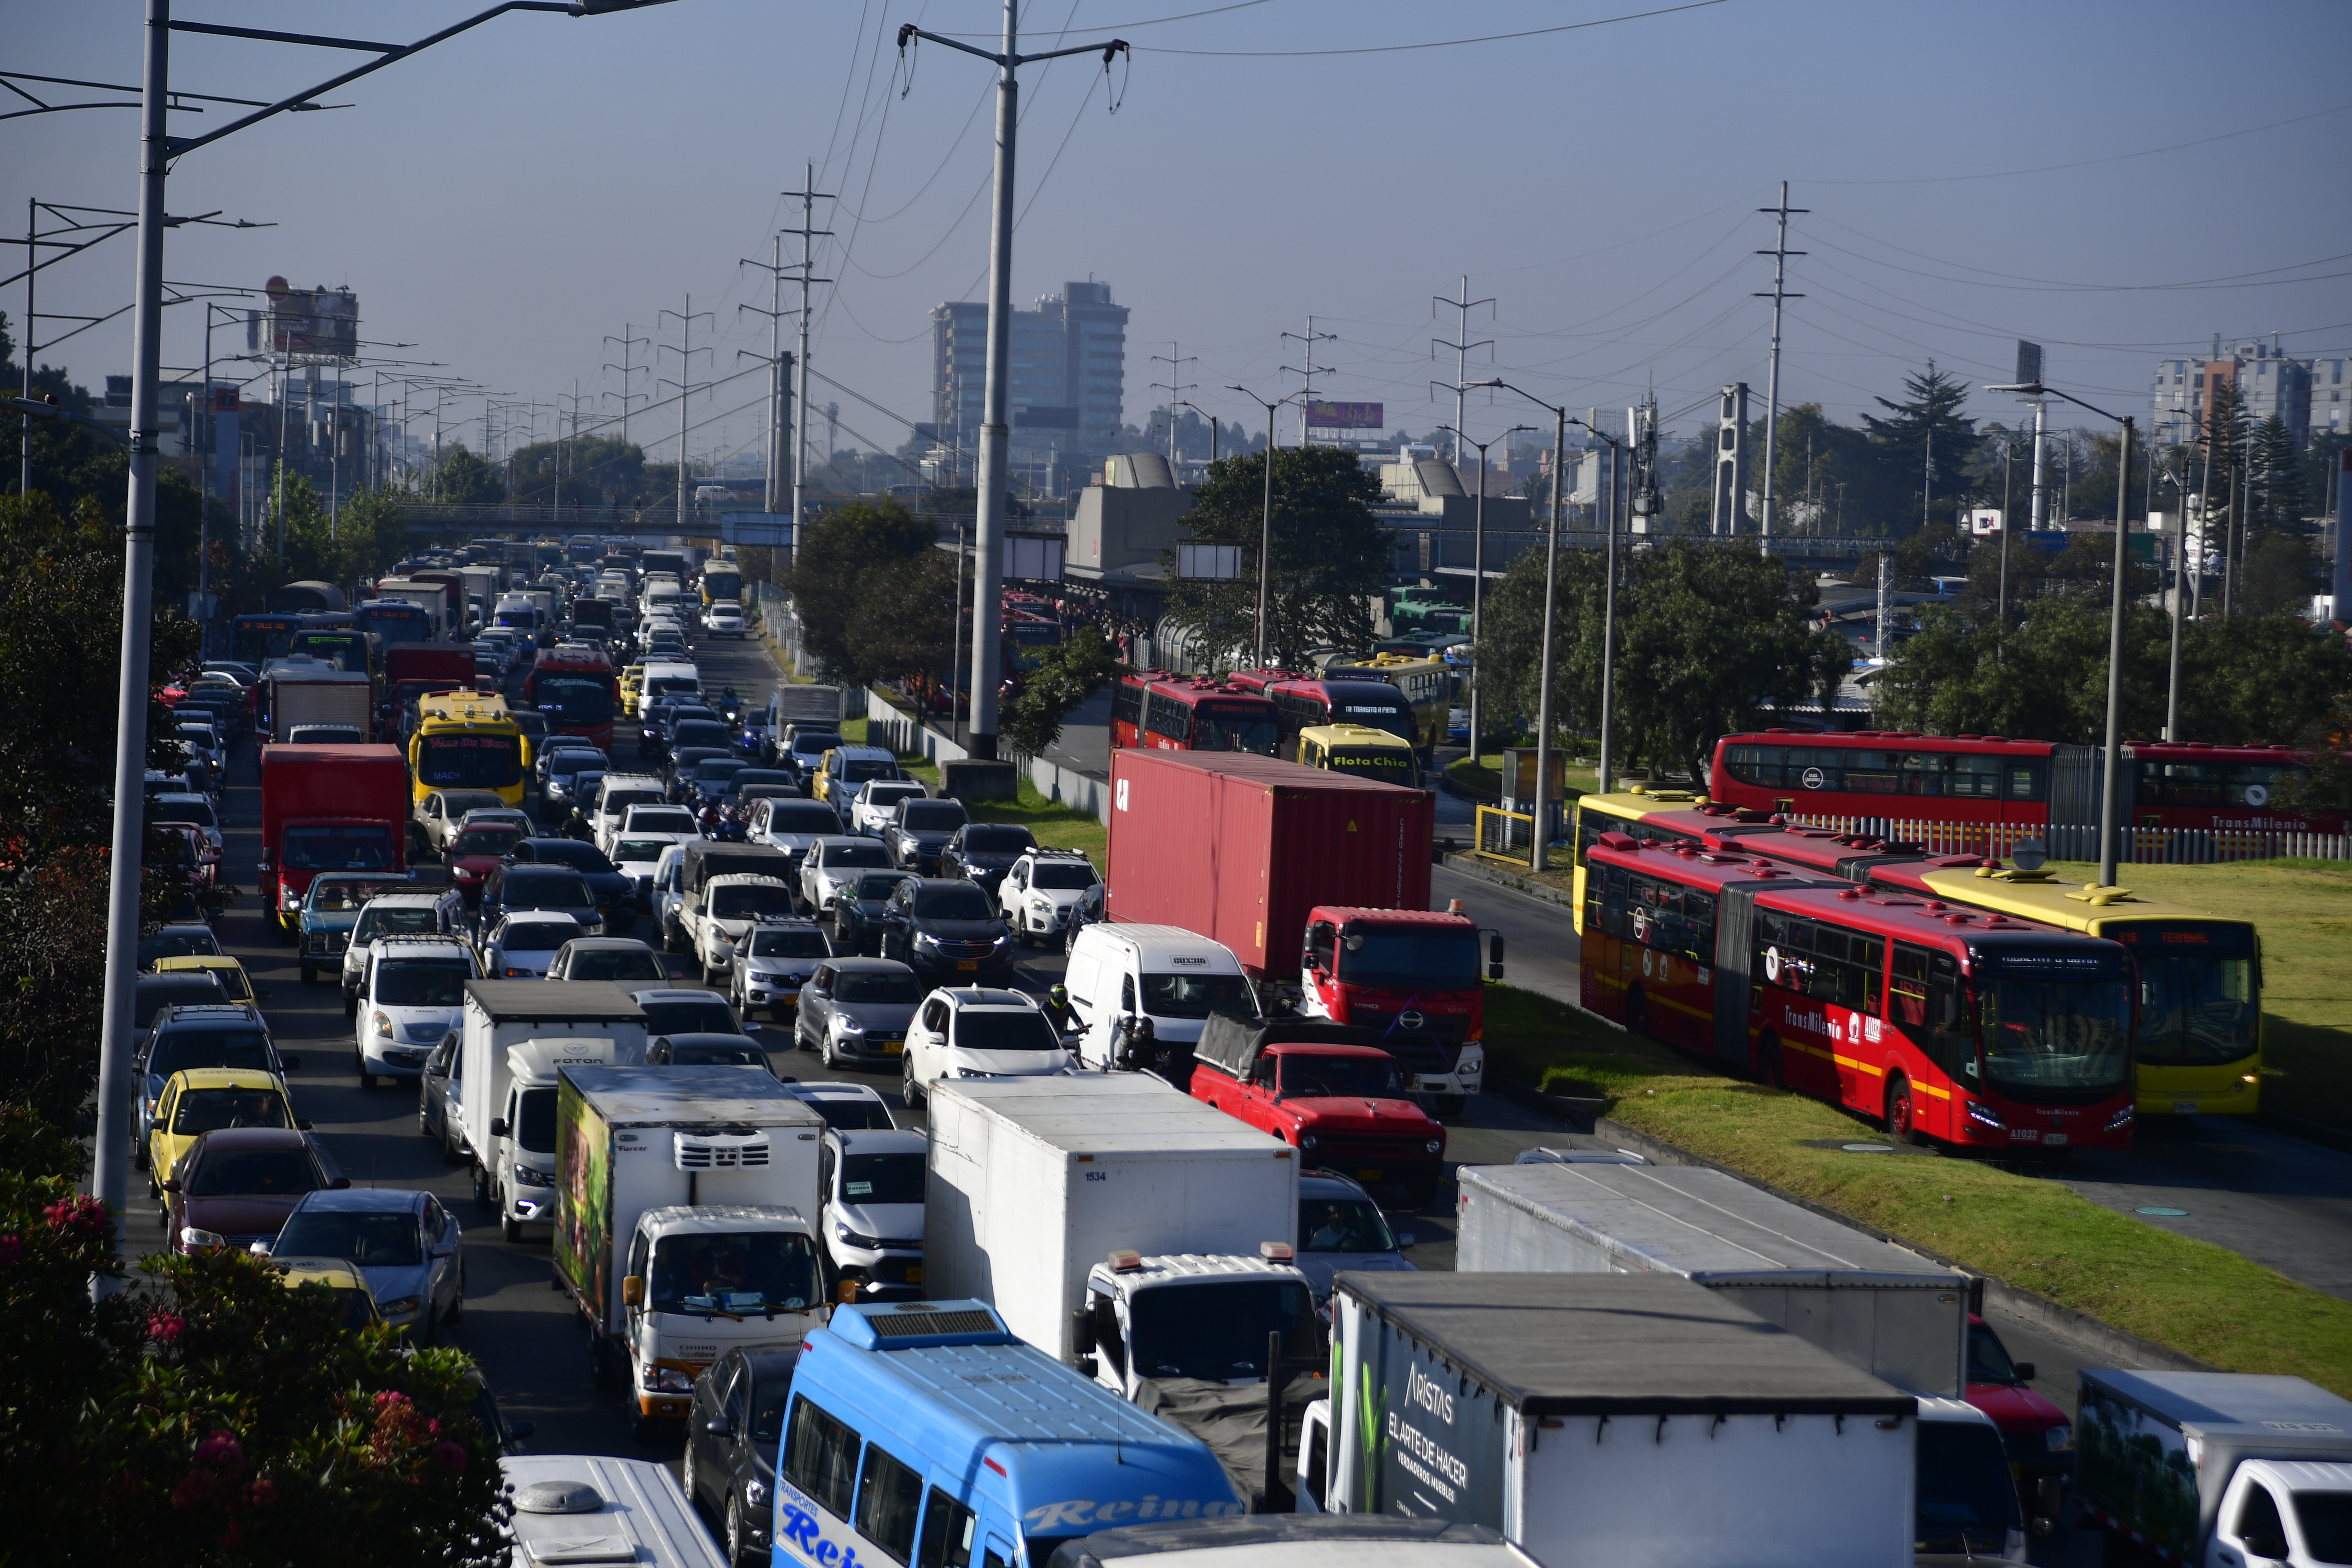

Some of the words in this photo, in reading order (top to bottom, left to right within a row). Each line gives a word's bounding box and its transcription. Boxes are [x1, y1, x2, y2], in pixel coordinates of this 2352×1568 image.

[1211, 704, 1243, 712] RETOMANDO
[1244, 706, 1267, 714] SERVICIO
[1334, 757, 1370, 766] Flota
[2211, 815, 2307, 830] TransMilenio
[2161, 932, 2208, 943] TERMINAL
[1785, 1004, 1841, 1040] TransMilenio
[1865, 1015, 1881, 1038] A1032
[2010, 1128, 2037, 1138] A1032
[1085, 1171, 1105, 1181] 1534
[1388, 1411, 1399, 1441] EL
[1399, 1420, 1421, 1456] ARTE
[1421, 1436, 1435, 1467] DE
[1436, 1445, 1466, 1489] HACER
[1397, 1449, 1430, 1485] VERDADEROS
[1431, 1475, 1454, 1505] MUEBLES
[778, 1479, 818, 1518] TRANSPORTES
